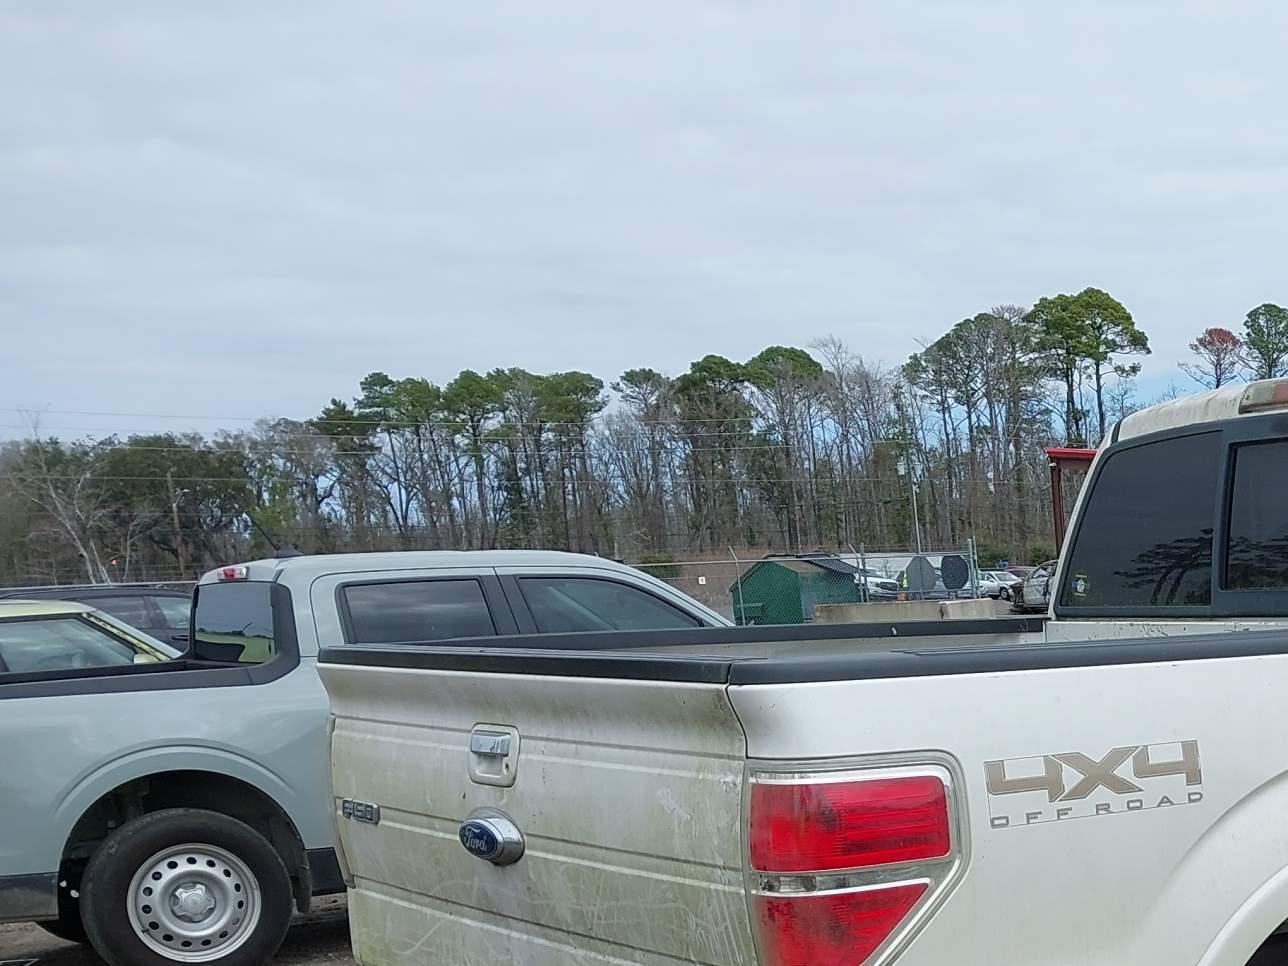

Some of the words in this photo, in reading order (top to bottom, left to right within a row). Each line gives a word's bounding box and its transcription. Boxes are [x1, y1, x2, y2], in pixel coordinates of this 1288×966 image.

[984, 740, 1202, 803] 4X4
[990, 807, 1073, 828] OFF
[1094, 792, 1204, 816] ROAD
